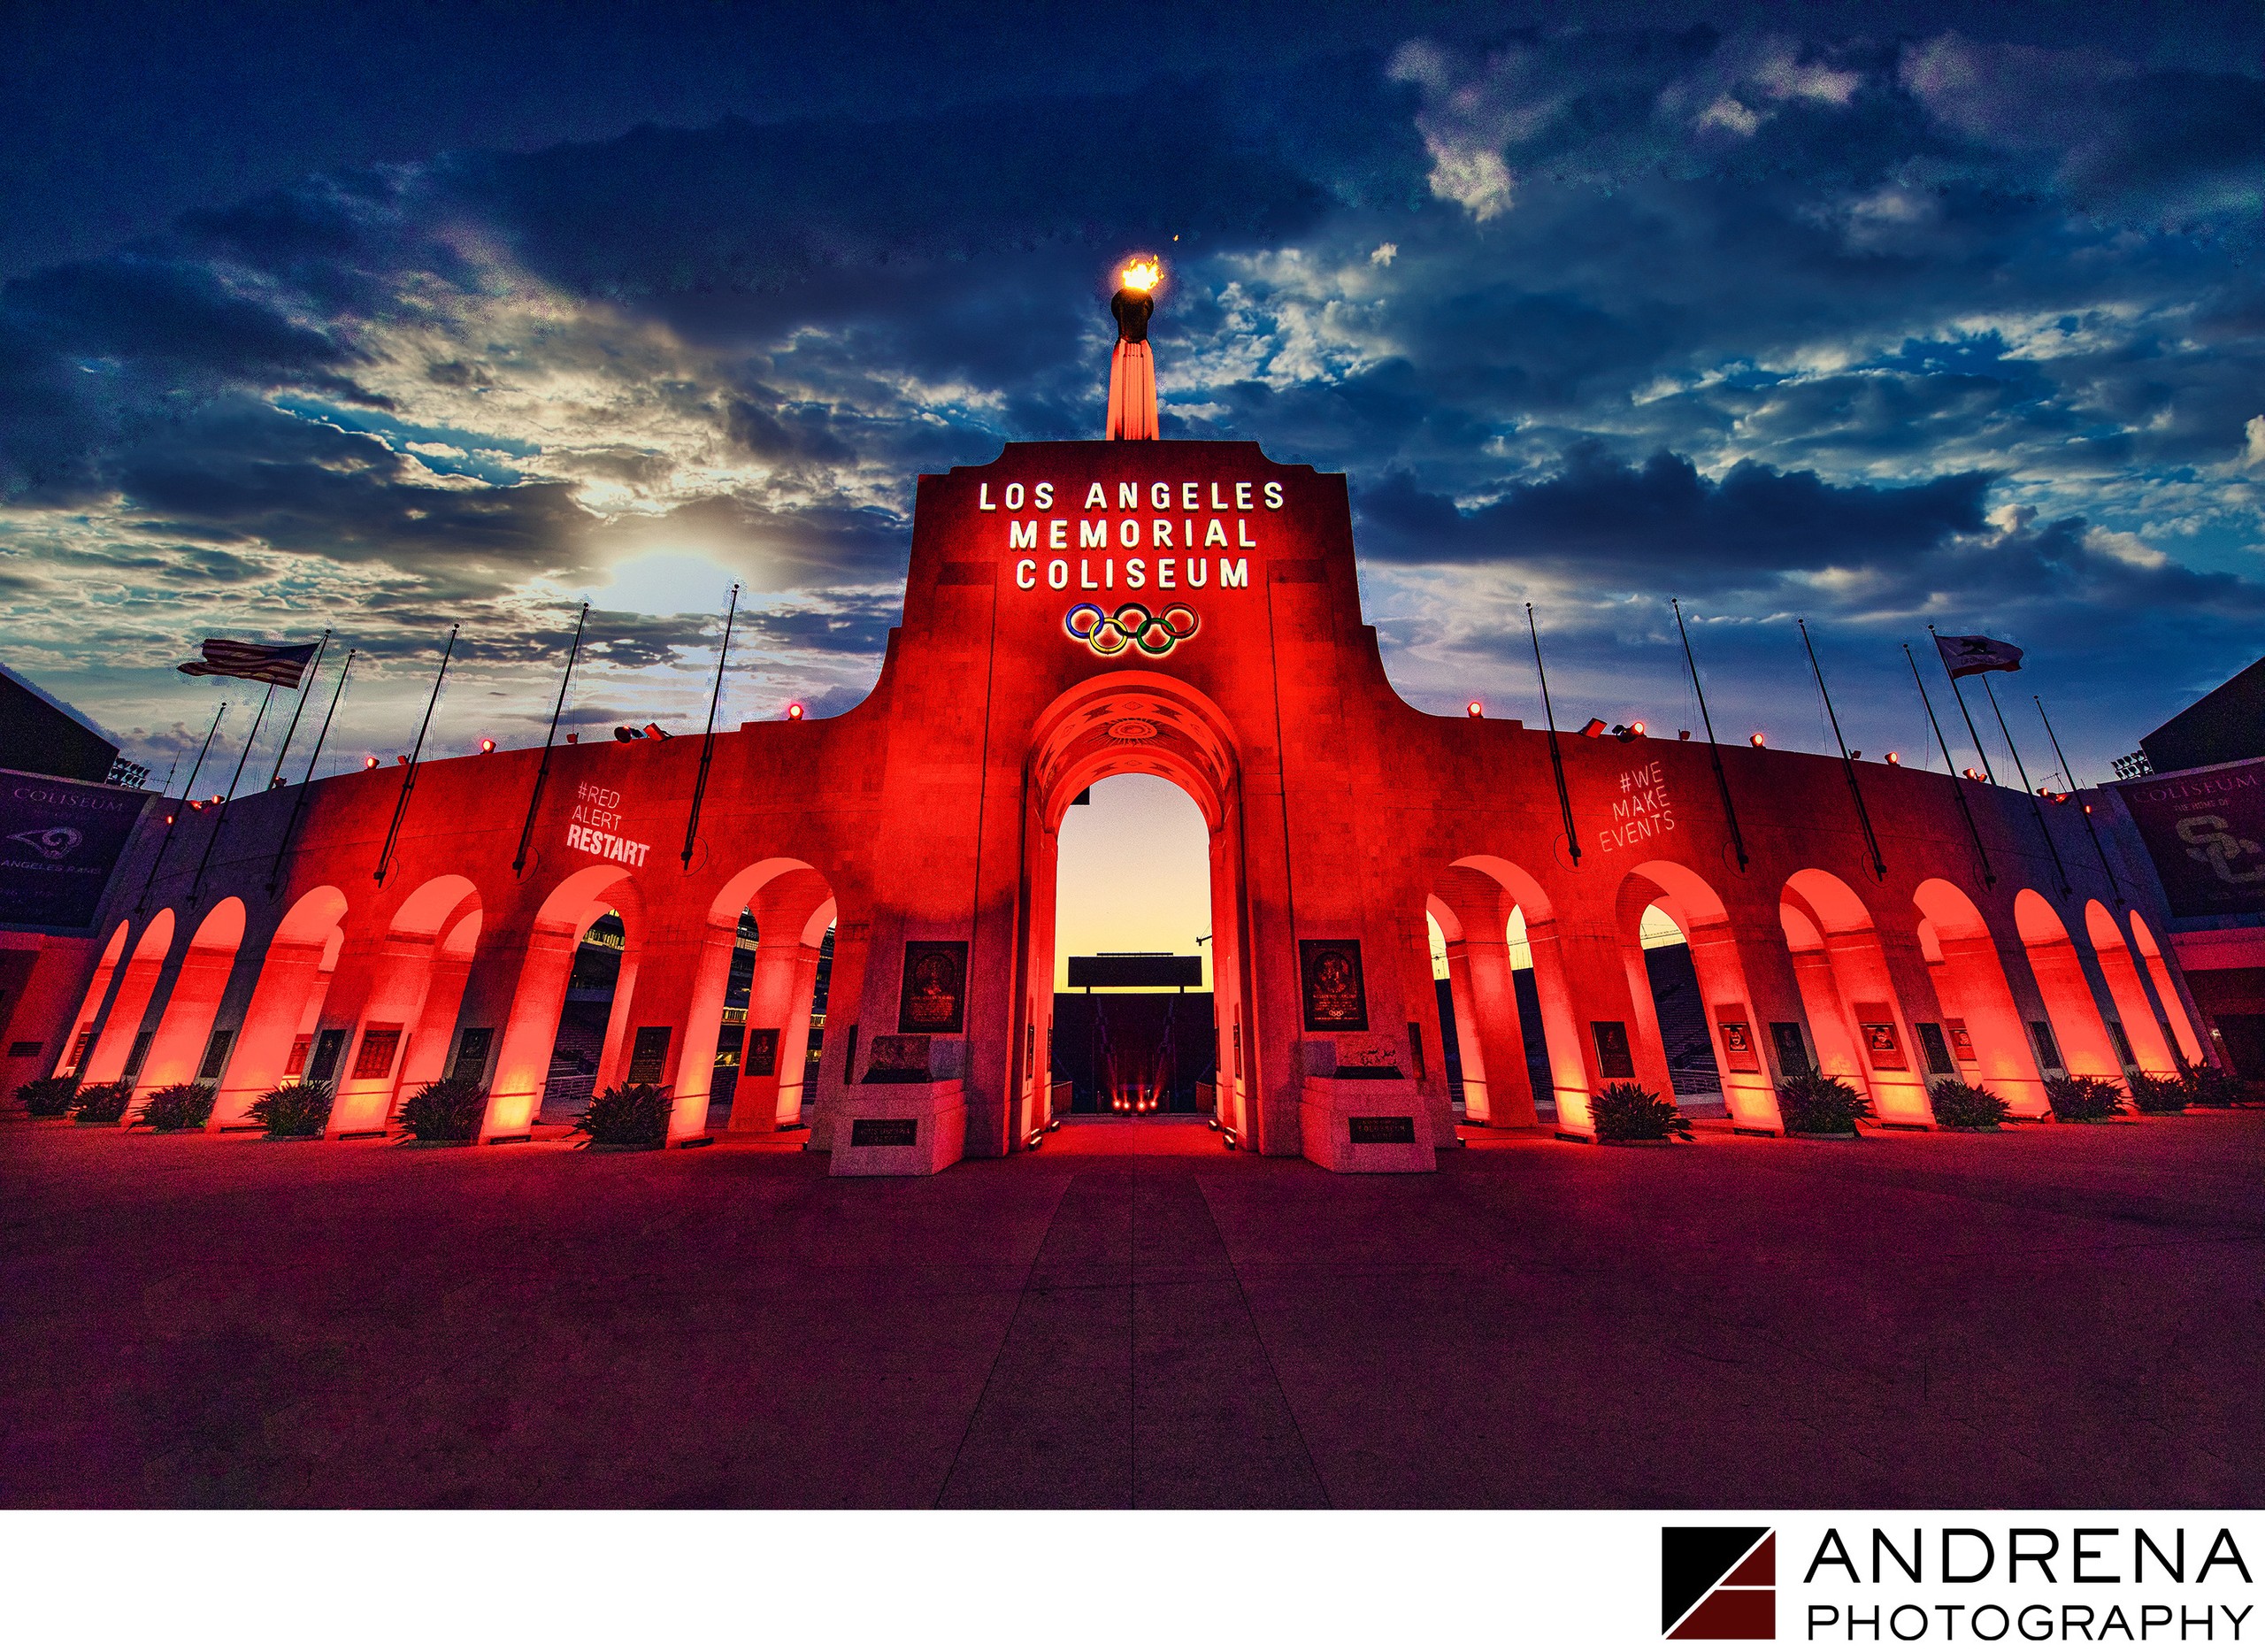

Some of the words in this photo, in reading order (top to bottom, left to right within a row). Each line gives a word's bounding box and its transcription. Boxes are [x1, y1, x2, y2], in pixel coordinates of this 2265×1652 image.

[979, 482, 1055, 512] LOS
[1084, 482, 1285, 511] ANGELES
[1010, 519, 1256, 550] MEMORIAL
[1016, 557, 1248, 590] COLISEUM
[1620, 761, 1663, 793] #WE
[2133, 774, 2259, 803] COLISEUM
[13, 788, 124, 812] COLISEUM
[578, 780, 620, 809] #RED
[1612, 785, 1670, 821] MAKE
[572, 804, 622, 831] ALERT
[1599, 810, 1675, 852] EVENTS
[566, 824, 650, 867] RESTART
